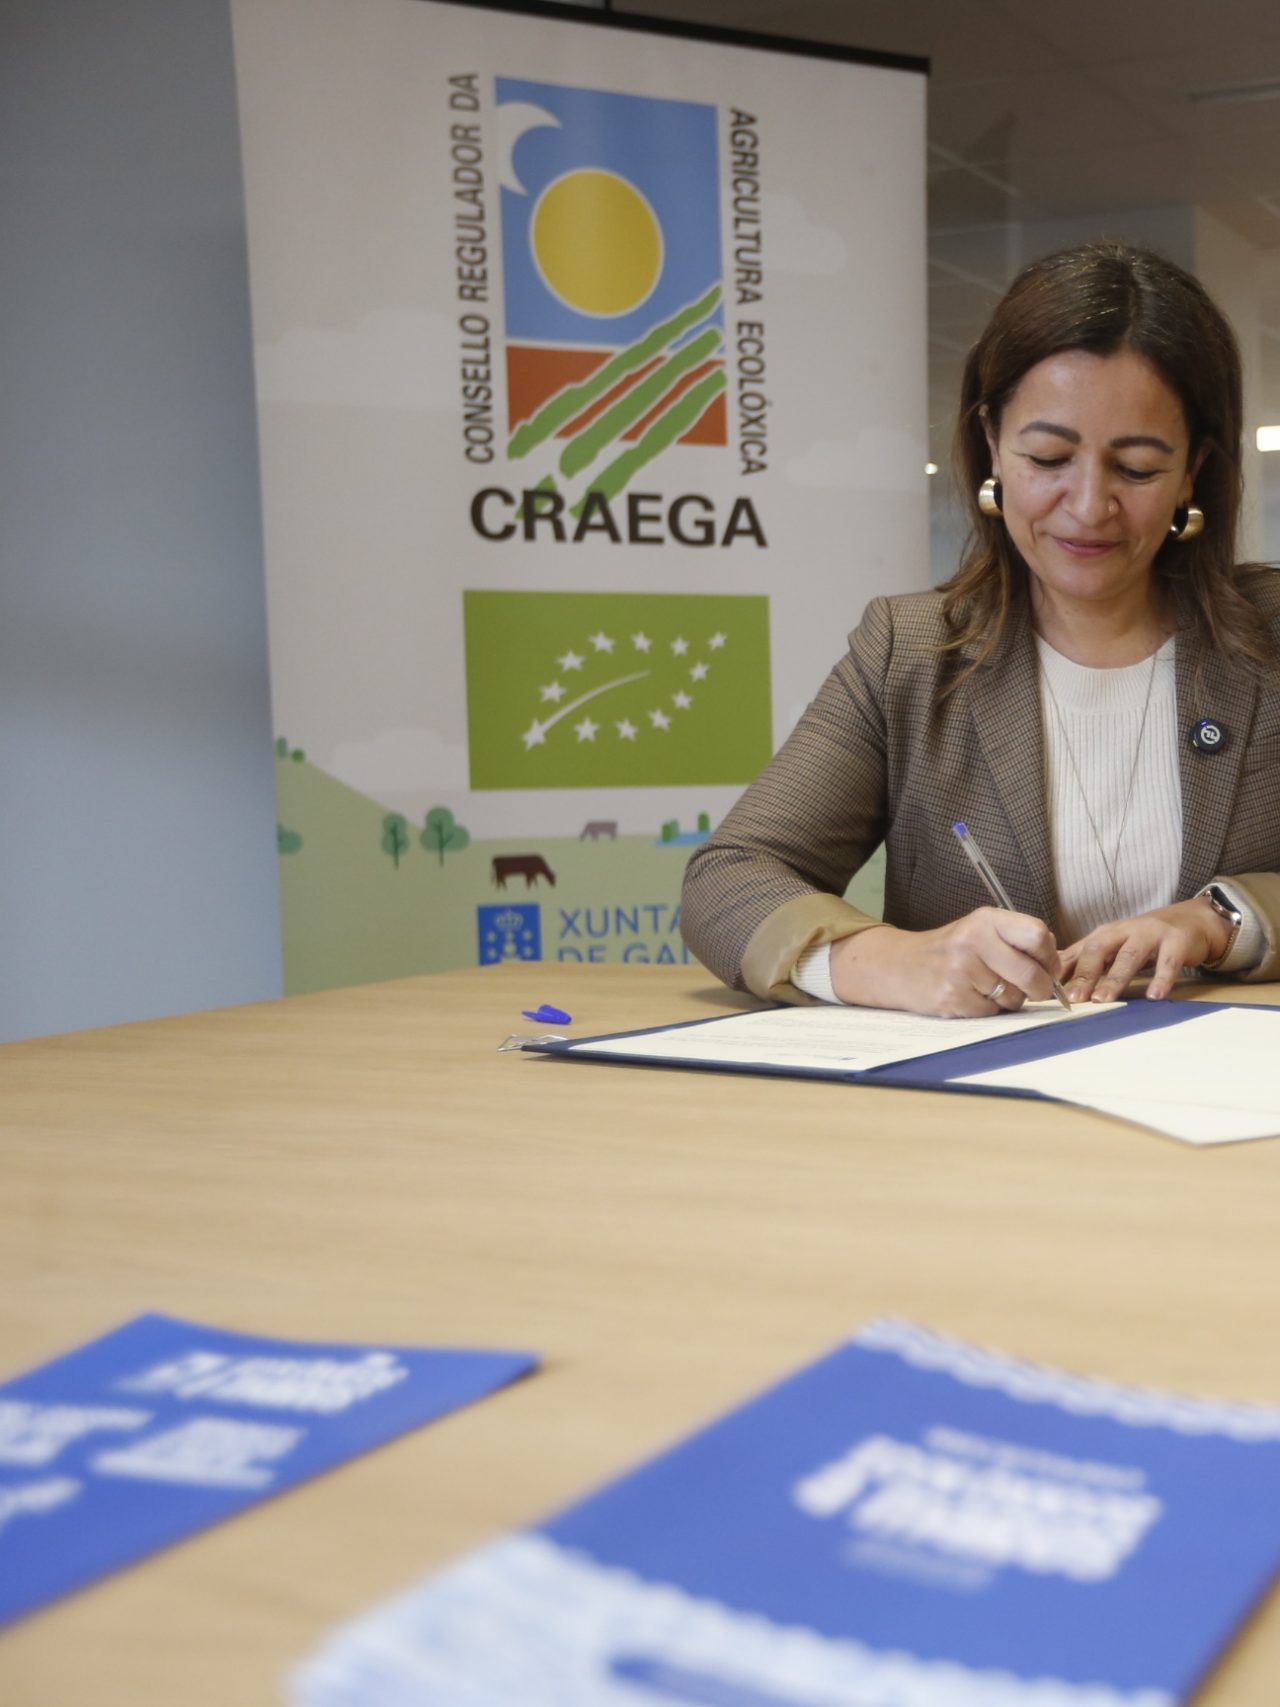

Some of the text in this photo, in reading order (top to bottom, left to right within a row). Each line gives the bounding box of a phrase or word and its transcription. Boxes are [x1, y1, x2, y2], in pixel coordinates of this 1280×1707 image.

[447, 72, 495, 465] CONSELLO REGULADOR DA
[729, 107, 772, 476] AGRICULTURA ECOLÓXICA
[469, 487, 769, 549] CRAEGA
